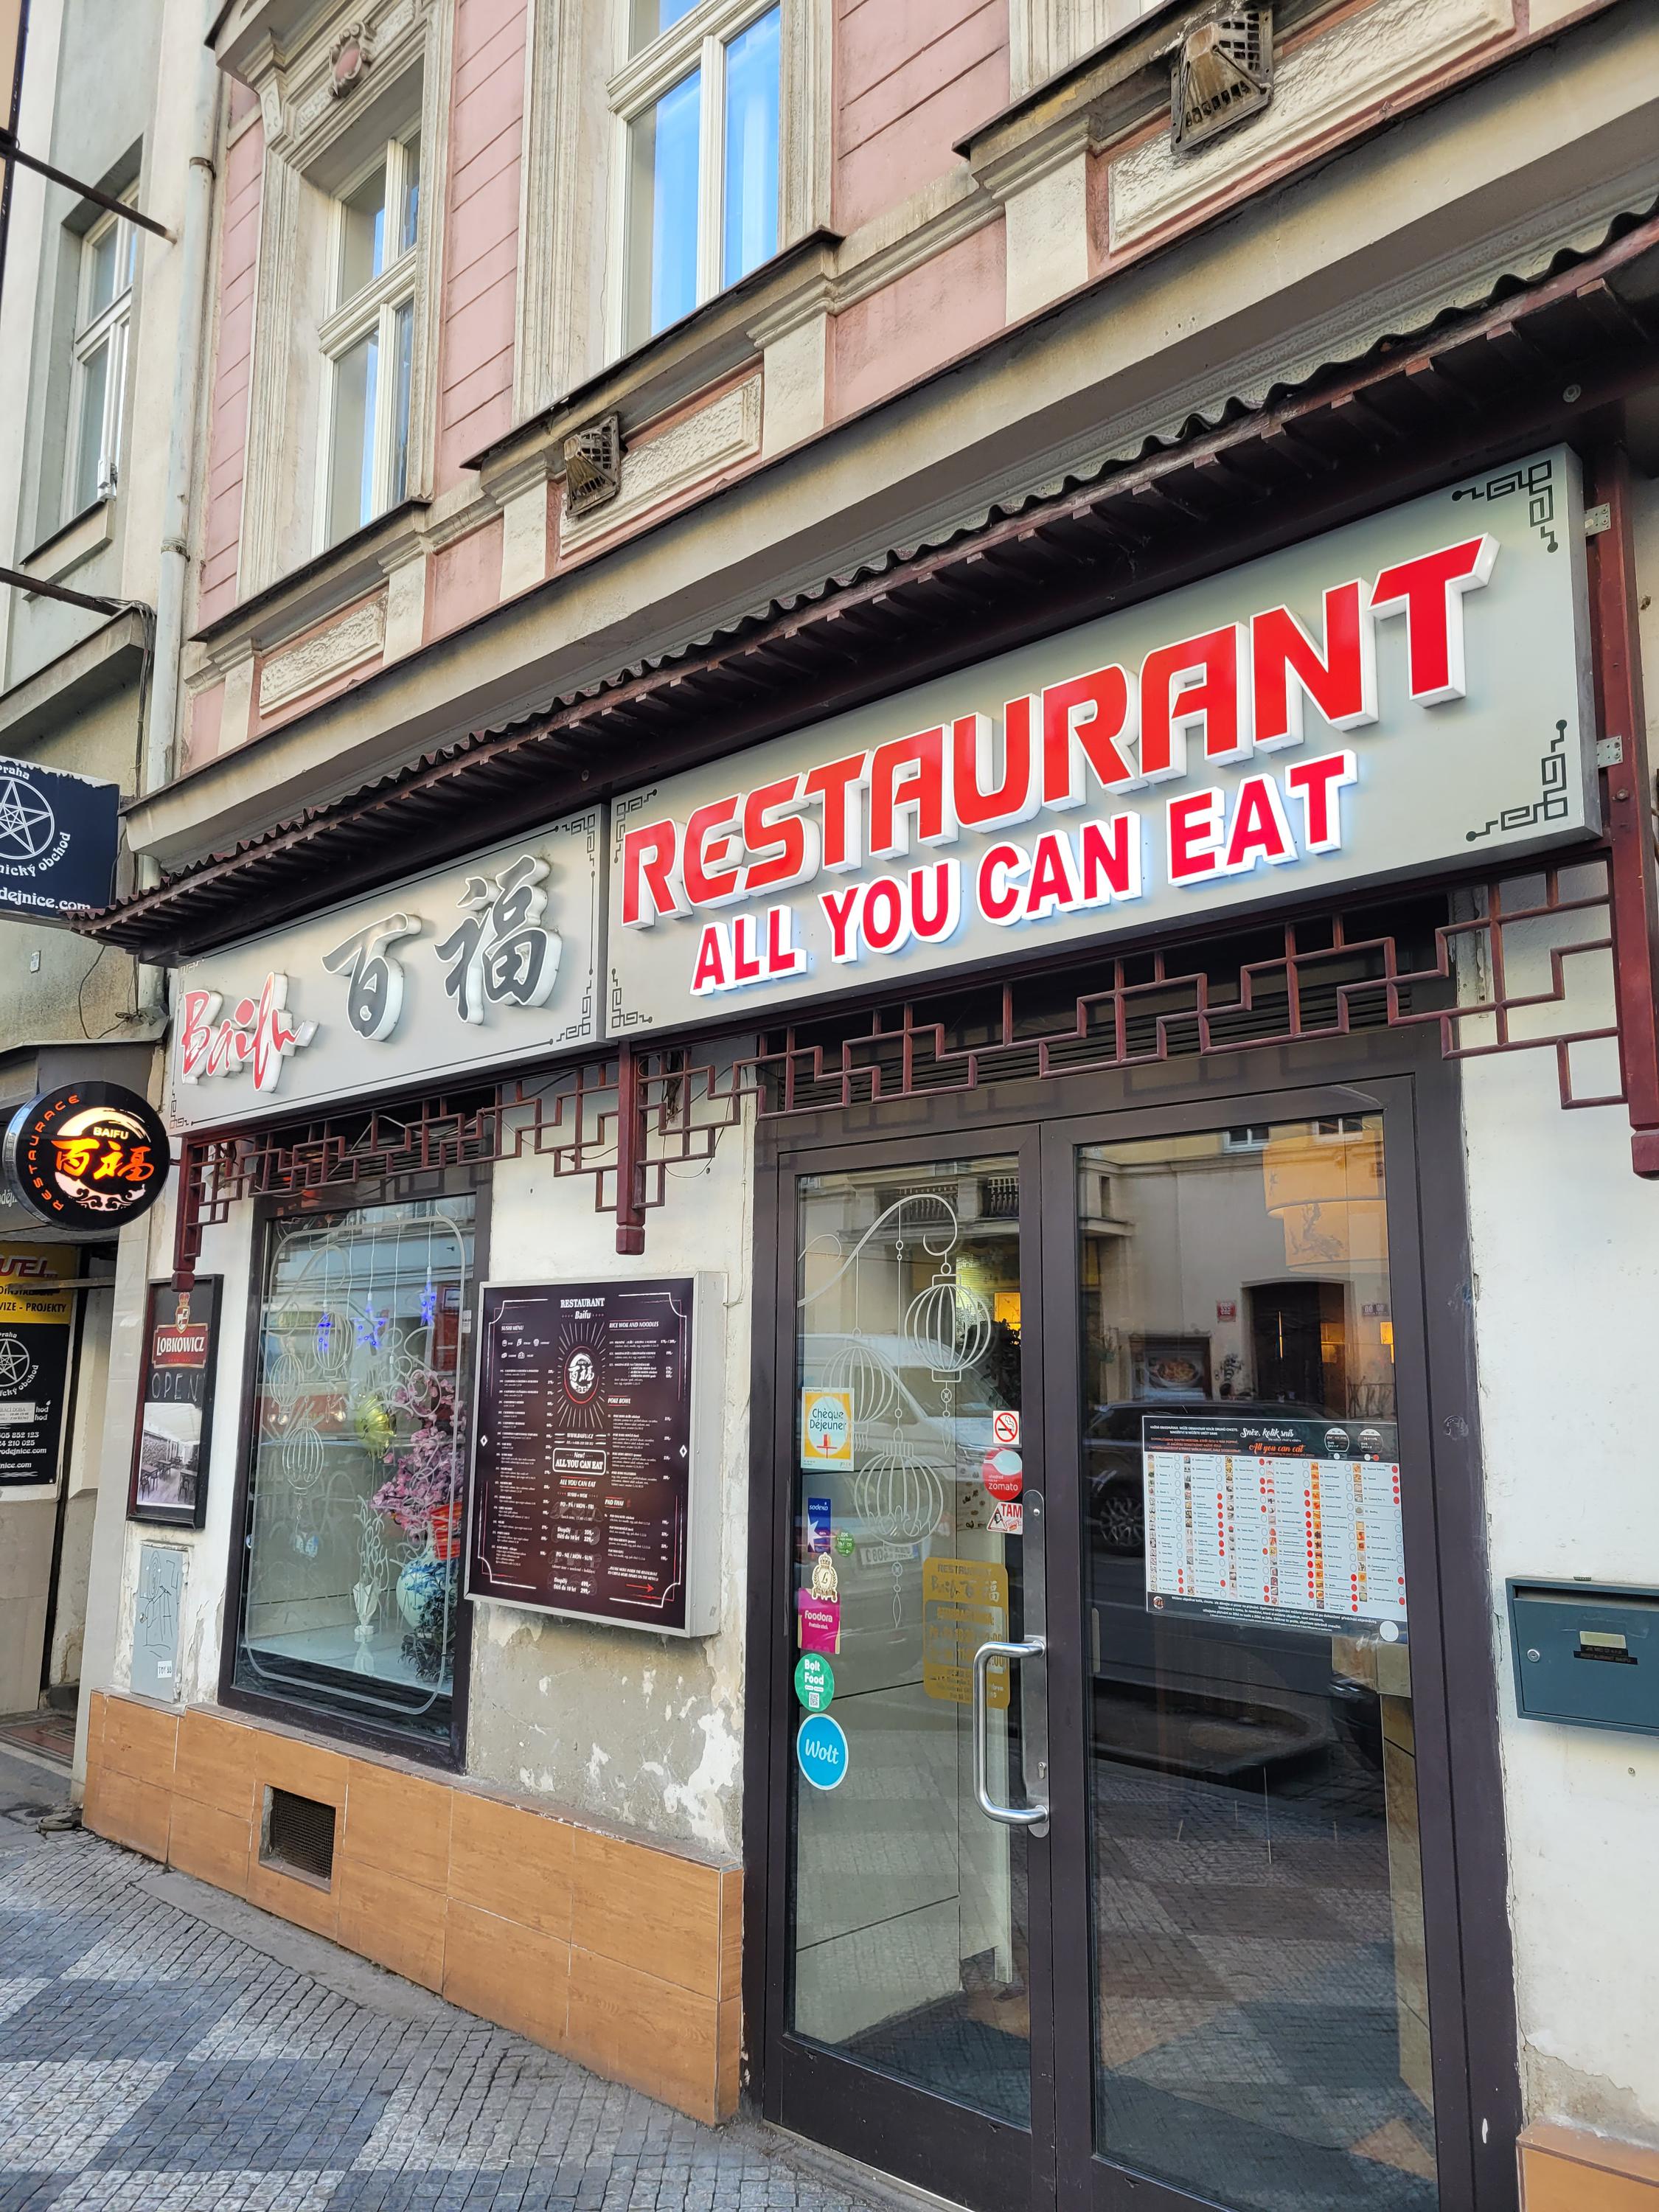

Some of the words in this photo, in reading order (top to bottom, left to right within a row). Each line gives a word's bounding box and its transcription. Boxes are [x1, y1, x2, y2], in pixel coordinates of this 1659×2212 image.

[621, 532, 1500, 930] RESTAURANT
[38, 831, 72, 872] obchod
[689, 905, 807, 995] ALL
[818, 858, 960, 964] YOU
[976, 810, 1142, 927] CAN
[1166, 749, 1357, 887] EAT
[93, 1127, 129, 1140] BAIFU
[28, 1094, 80, 1211] RESTAURACE
[26, 1302, 66, 1312] PROJEKTY
[560, 1298, 605, 1308] RESTAURANT
[574, 1310, 591, 1320] Baifu
[156, 1336, 205, 1356] LOBKOWICZ
[18, 1364, 39, 1390] obchod
[151, 1371, 200, 1402] OPEN
[813, 1408, 844, 1421] Chèque
[1240, 1427, 1261, 1438] Sněz,
[1281, 1429, 1294, 1437] sníš
[1249, 1443, 1262, 1455] All
[1263, 1445, 1276, 1454] you
[1293, 1444, 1306, 1453] eat
[555, 1459, 566, 1467] ALL
[566, 1459, 579, 1468] YOU
[580, 1461, 591, 1469] CAN
[591, 1461, 603, 1470] EAT
[989, 1483, 1018, 1491] zomato
[1001, 1503, 1022, 1518] TAM
[804, 1659, 820, 1672] Bolt
[804, 1672, 824, 1686] Food
[805, 1739, 839, 1764] Wolt
